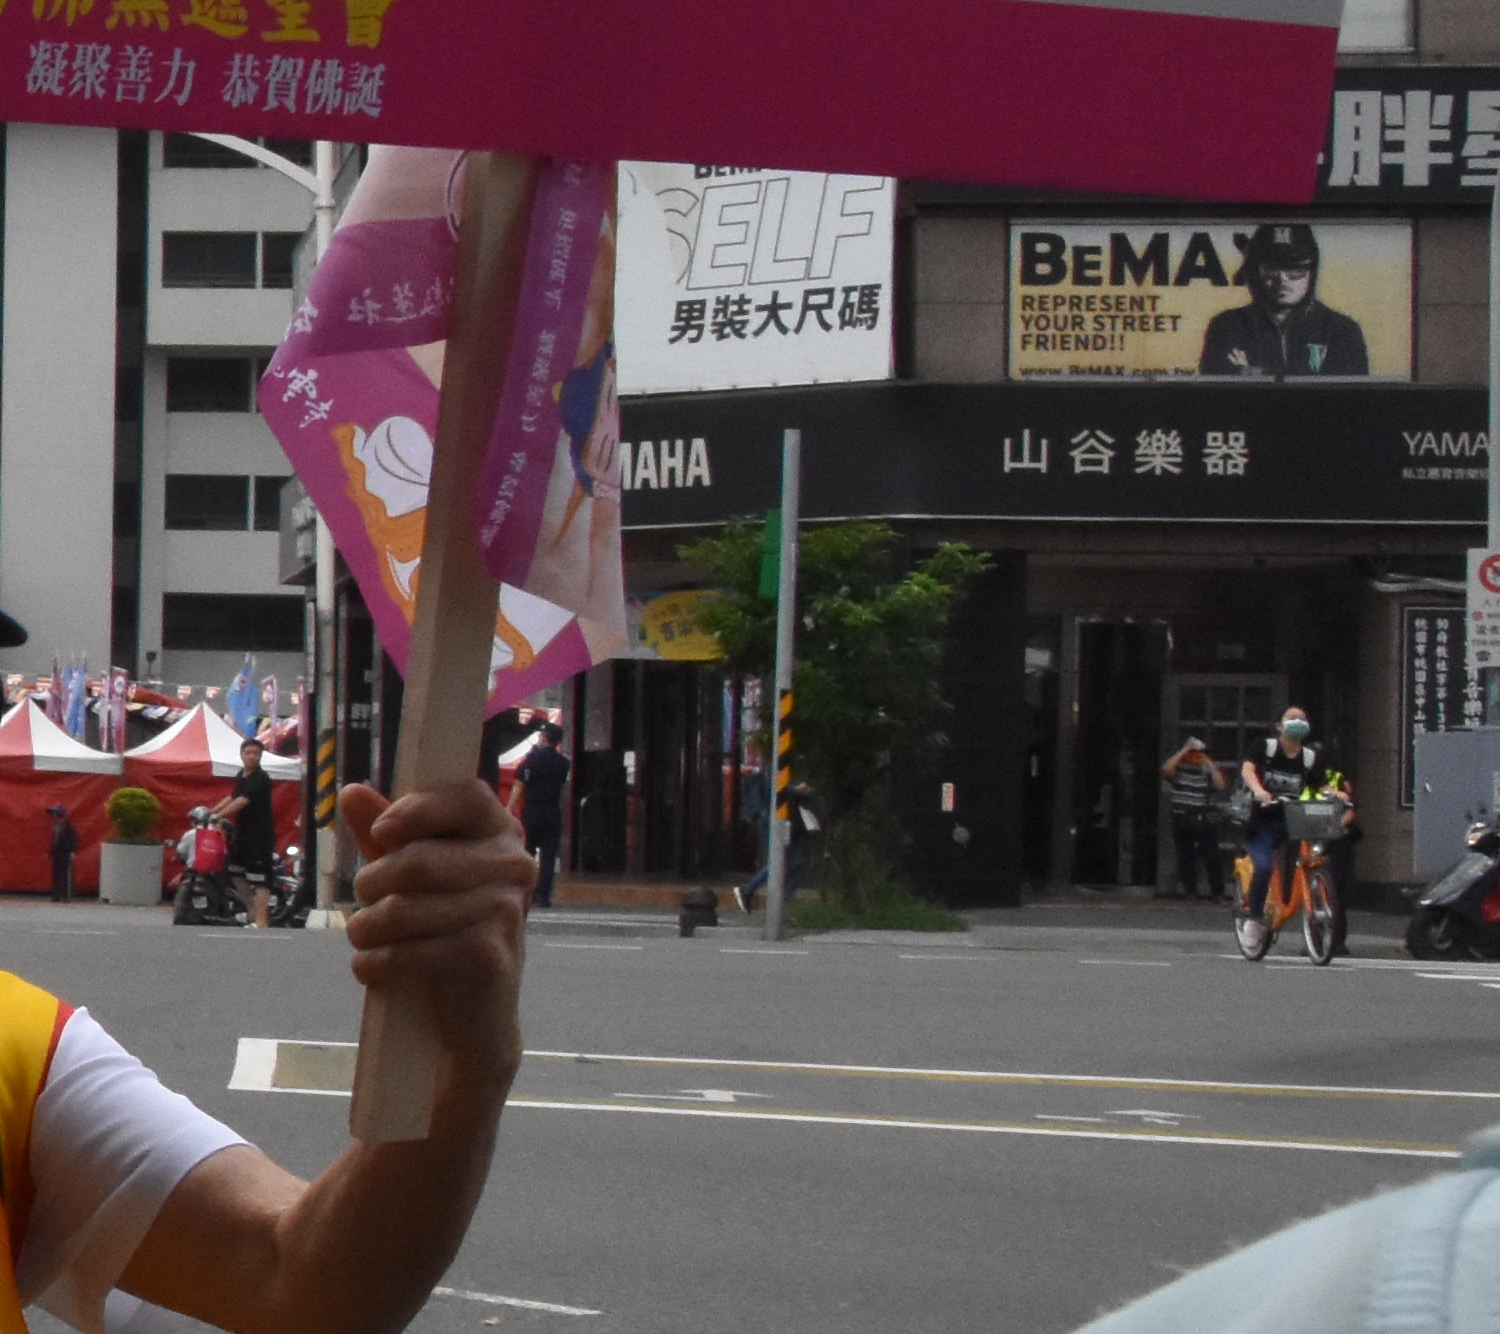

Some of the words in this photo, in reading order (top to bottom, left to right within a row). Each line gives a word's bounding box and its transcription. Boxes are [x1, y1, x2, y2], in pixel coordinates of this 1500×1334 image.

[25, 37, 198, 108] 凝聚善力
[220, 52, 387, 119] 恭賀佛誕
[668, 283, 883, 345] 男裝大尺碼
[1020, 294, 1161, 313] REPRESENT
[1020, 314, 1086, 333] YOUR
[1092, 314, 1182, 333] STREET
[1020, 334, 1125, 352] FRIEND!!
[1003, 428, 1250, 476] 山谷樂器
